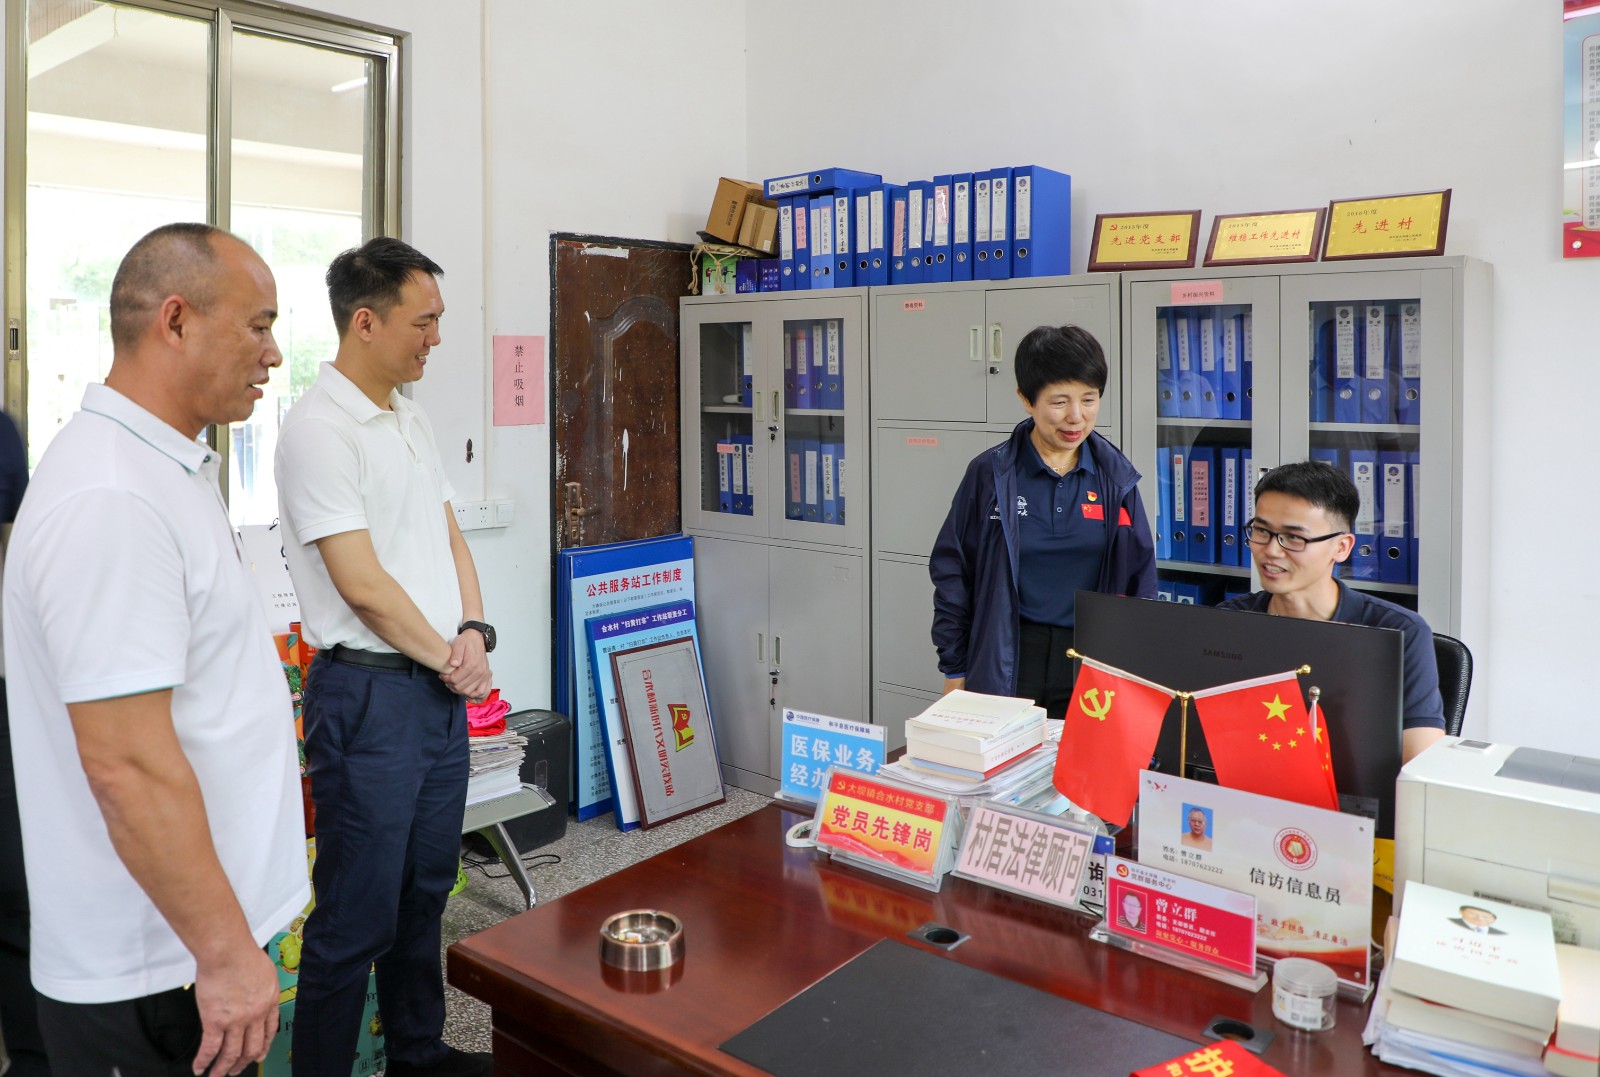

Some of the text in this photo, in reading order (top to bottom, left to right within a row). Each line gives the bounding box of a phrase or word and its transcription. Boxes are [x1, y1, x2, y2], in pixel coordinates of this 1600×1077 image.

[1347, 208, 1378, 217] 2016年度
[1352, 217, 1413, 234] 先进村
[1111, 234, 1181, 246] 先进党支部
[1228, 229, 1301, 243] 维稳工作先进村
[514, 345, 524, 407] 禁止吸烟
[586, 567, 682, 597] 公共服务站工作制度
[1203, 648, 1243, 661] SAMSUNG
[641, 668, 675, 797] 合水村新时代文明实践站
[829, 721, 871, 734] 和平县医疗保障局
[791, 734, 875, 773] 医保业务
[848, 782, 936, 815] 大坝镇合水村党支部
[831, 804, 933, 853] 党员先锋岗
[968, 811, 1091, 897] 村居法律顾问
[1131, 873, 1172, 890] 党群服务中心
[1249, 867, 1341, 905] 信访信息员
[1156, 898, 1197, 921] 曾立群
